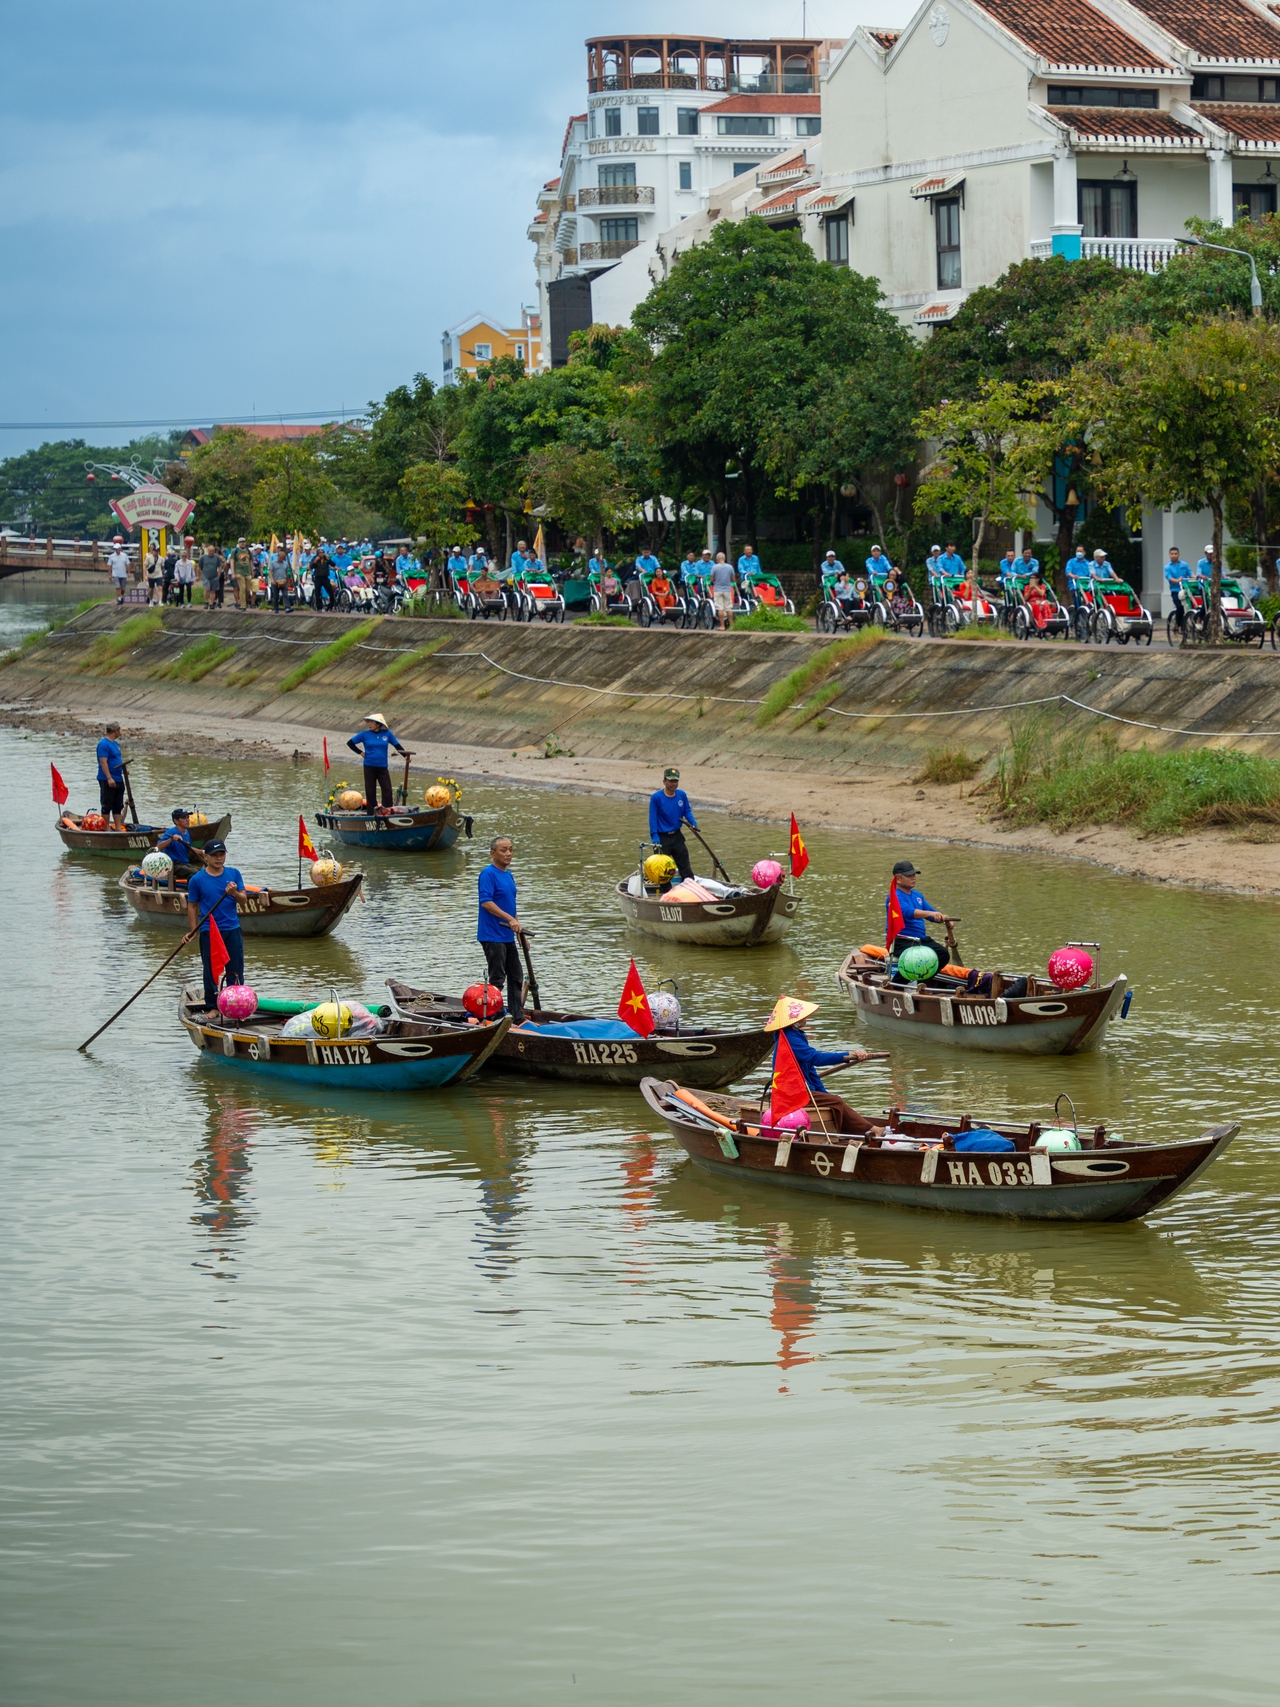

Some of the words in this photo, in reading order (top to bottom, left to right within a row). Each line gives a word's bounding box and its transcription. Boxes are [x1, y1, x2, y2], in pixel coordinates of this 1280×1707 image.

[626, 95, 650, 105] BAR
[614, 139, 657, 152] ROYAL
[136, 509, 151, 518] NIGHT
[151, 509, 172, 518] MARKET
[959, 1004, 998, 1025] HA.018
[947, 1161, 985, 1186] HA
[988, 1162, 1033, 1186] 033
